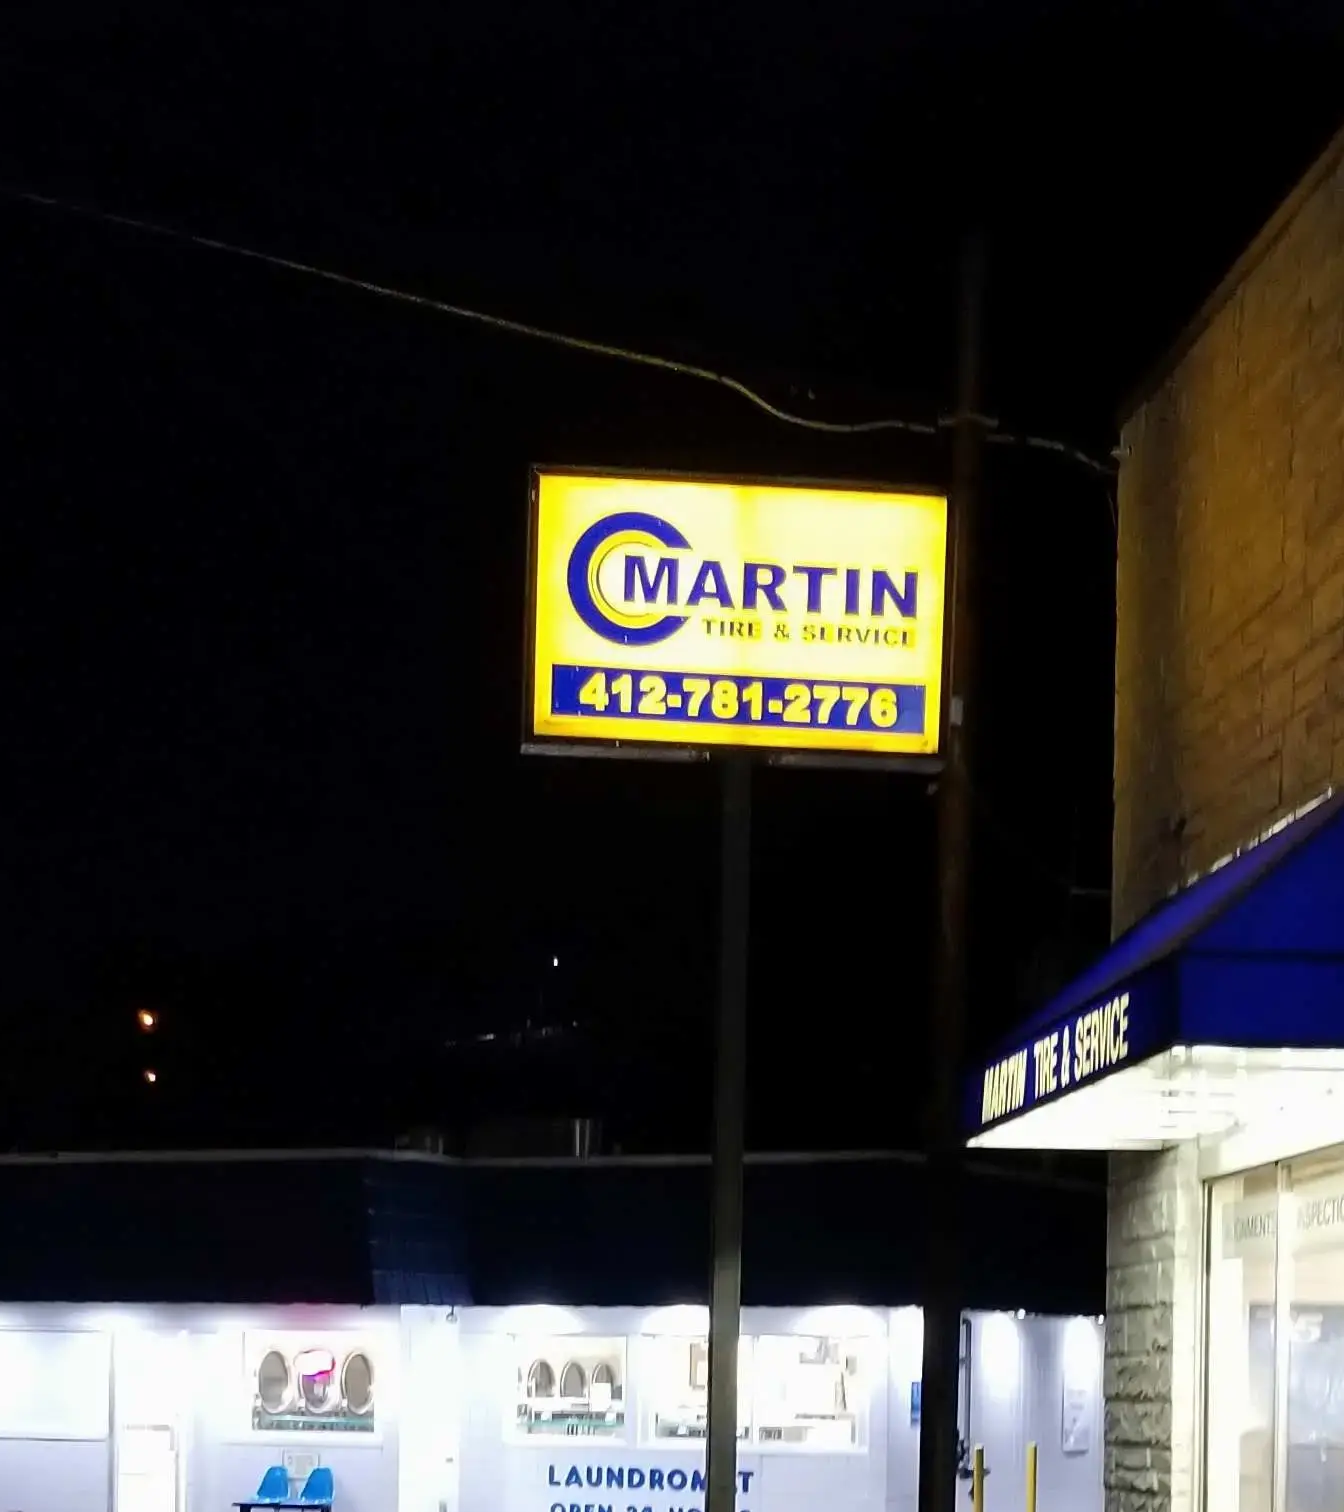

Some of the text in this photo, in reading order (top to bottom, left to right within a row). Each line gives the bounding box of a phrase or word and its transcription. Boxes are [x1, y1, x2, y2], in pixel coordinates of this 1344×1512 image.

[623, 554, 919, 620] MARTIN
[702, 617, 915, 647] TIRE & SERVICE
[579, 672, 898, 727] 412-781-2776
[982, 992, 1129, 1124] MARTIN TIRE & SERVICE
[548, 1464, 754, 1493] LAUNDROMT
